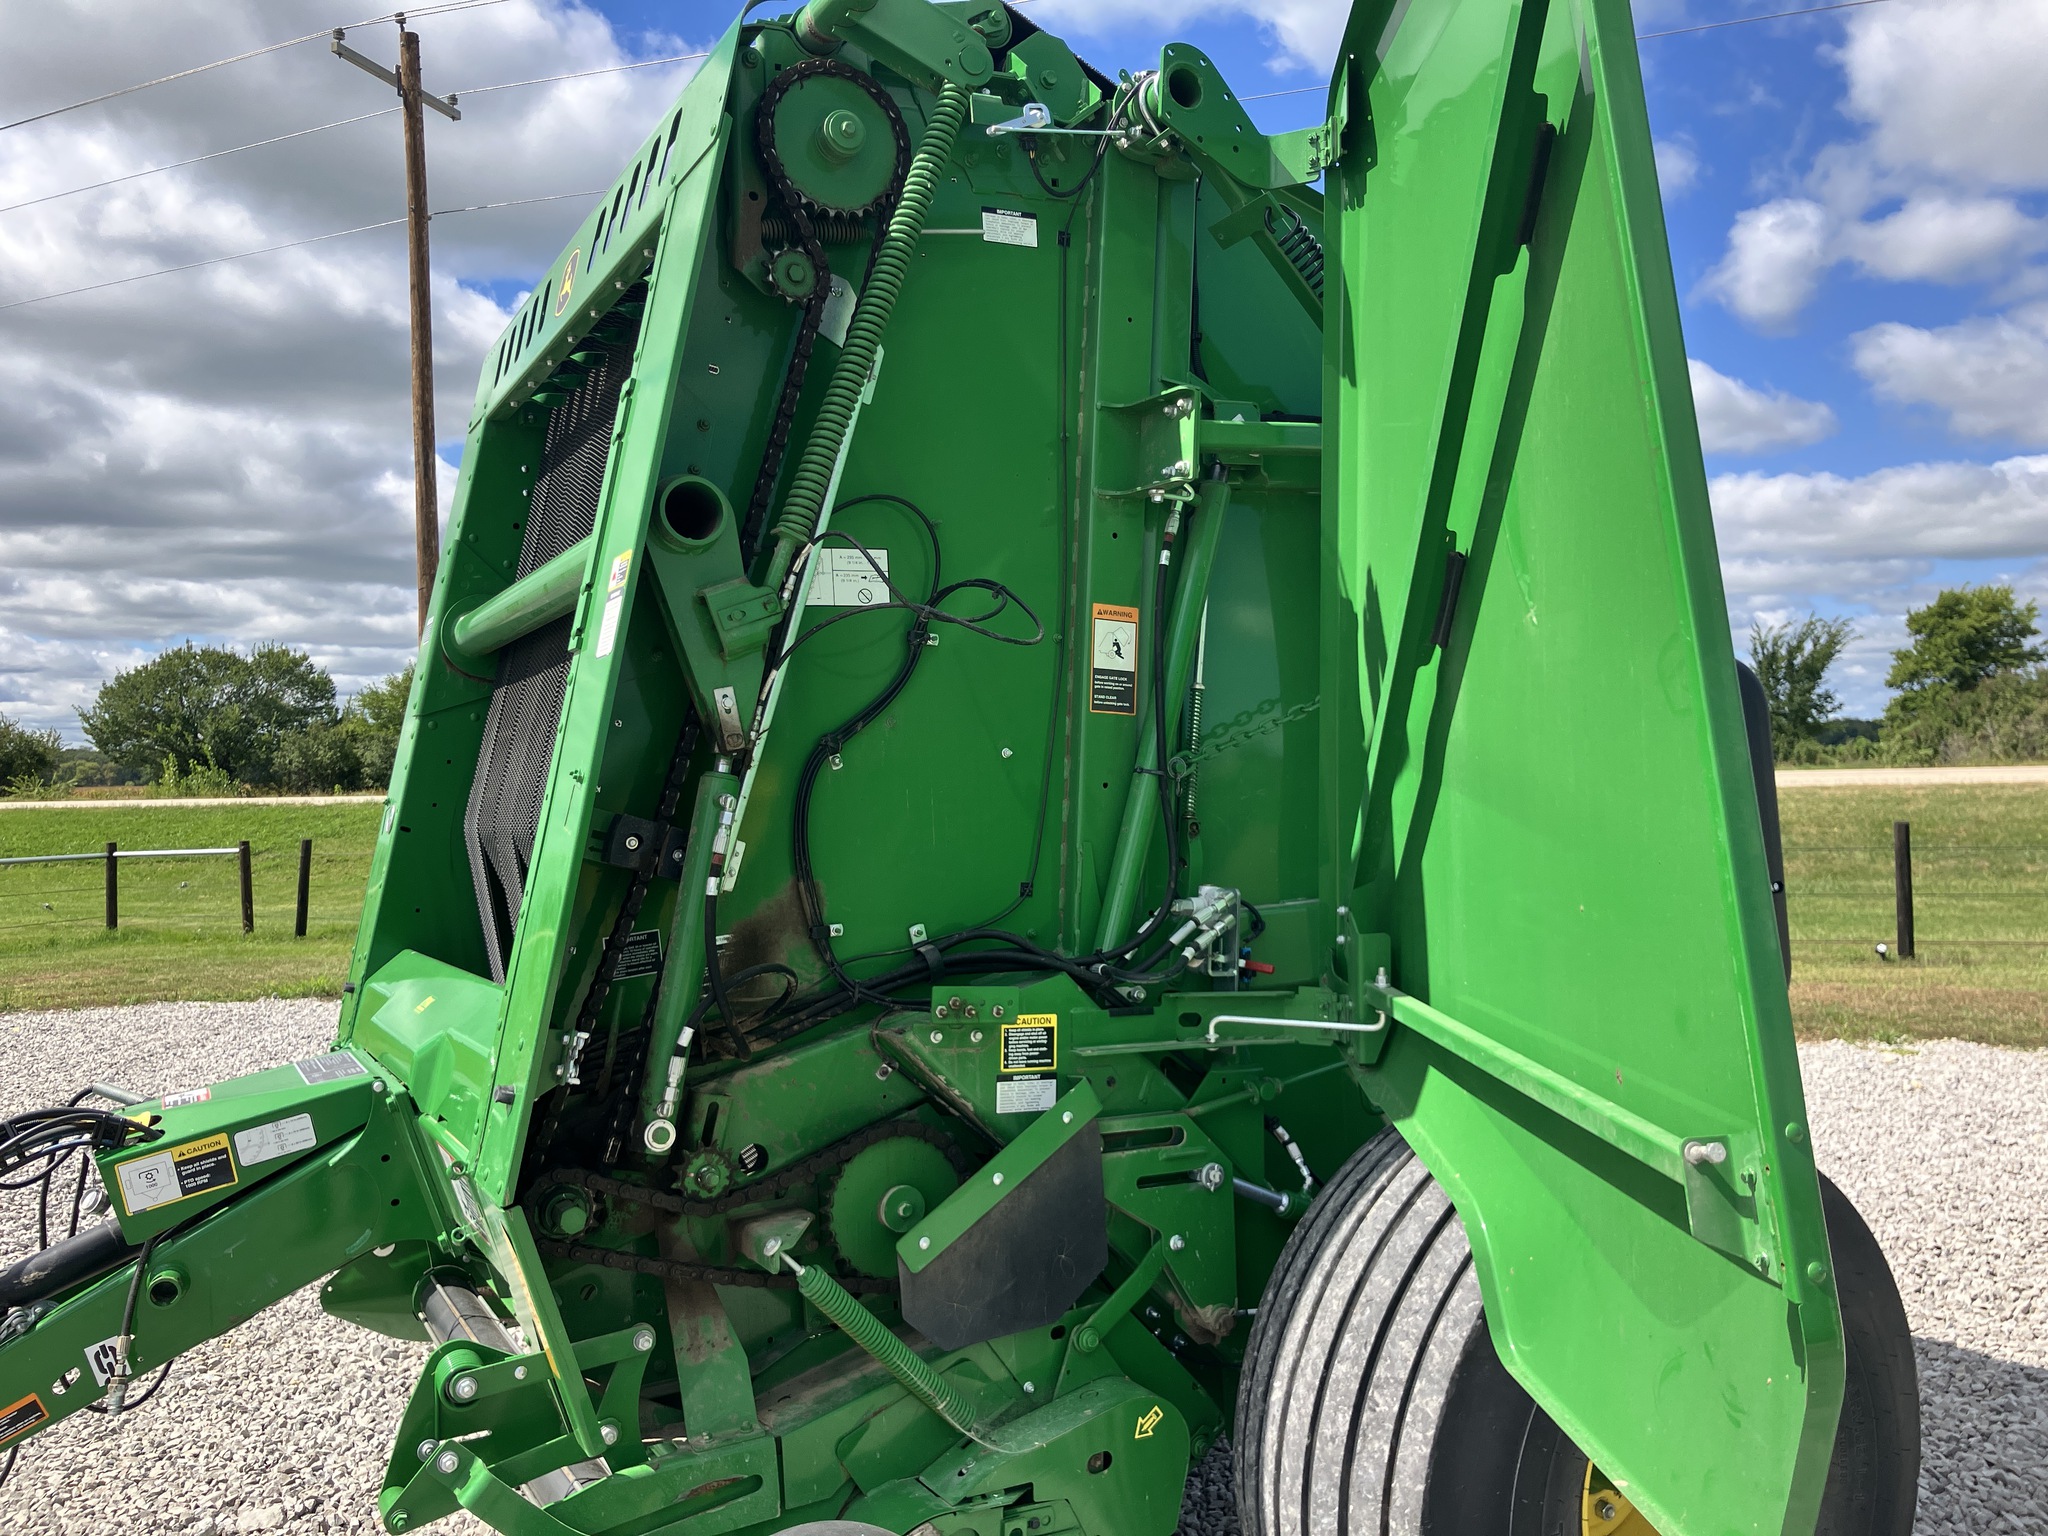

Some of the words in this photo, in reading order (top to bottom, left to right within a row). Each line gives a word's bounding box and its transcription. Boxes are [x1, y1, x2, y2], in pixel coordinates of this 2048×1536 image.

[1102, 610, 1133, 618] WARNING
[1016, 1017, 1051, 1025] CAUTION
[186, 1140, 221, 1155] CAUTION
